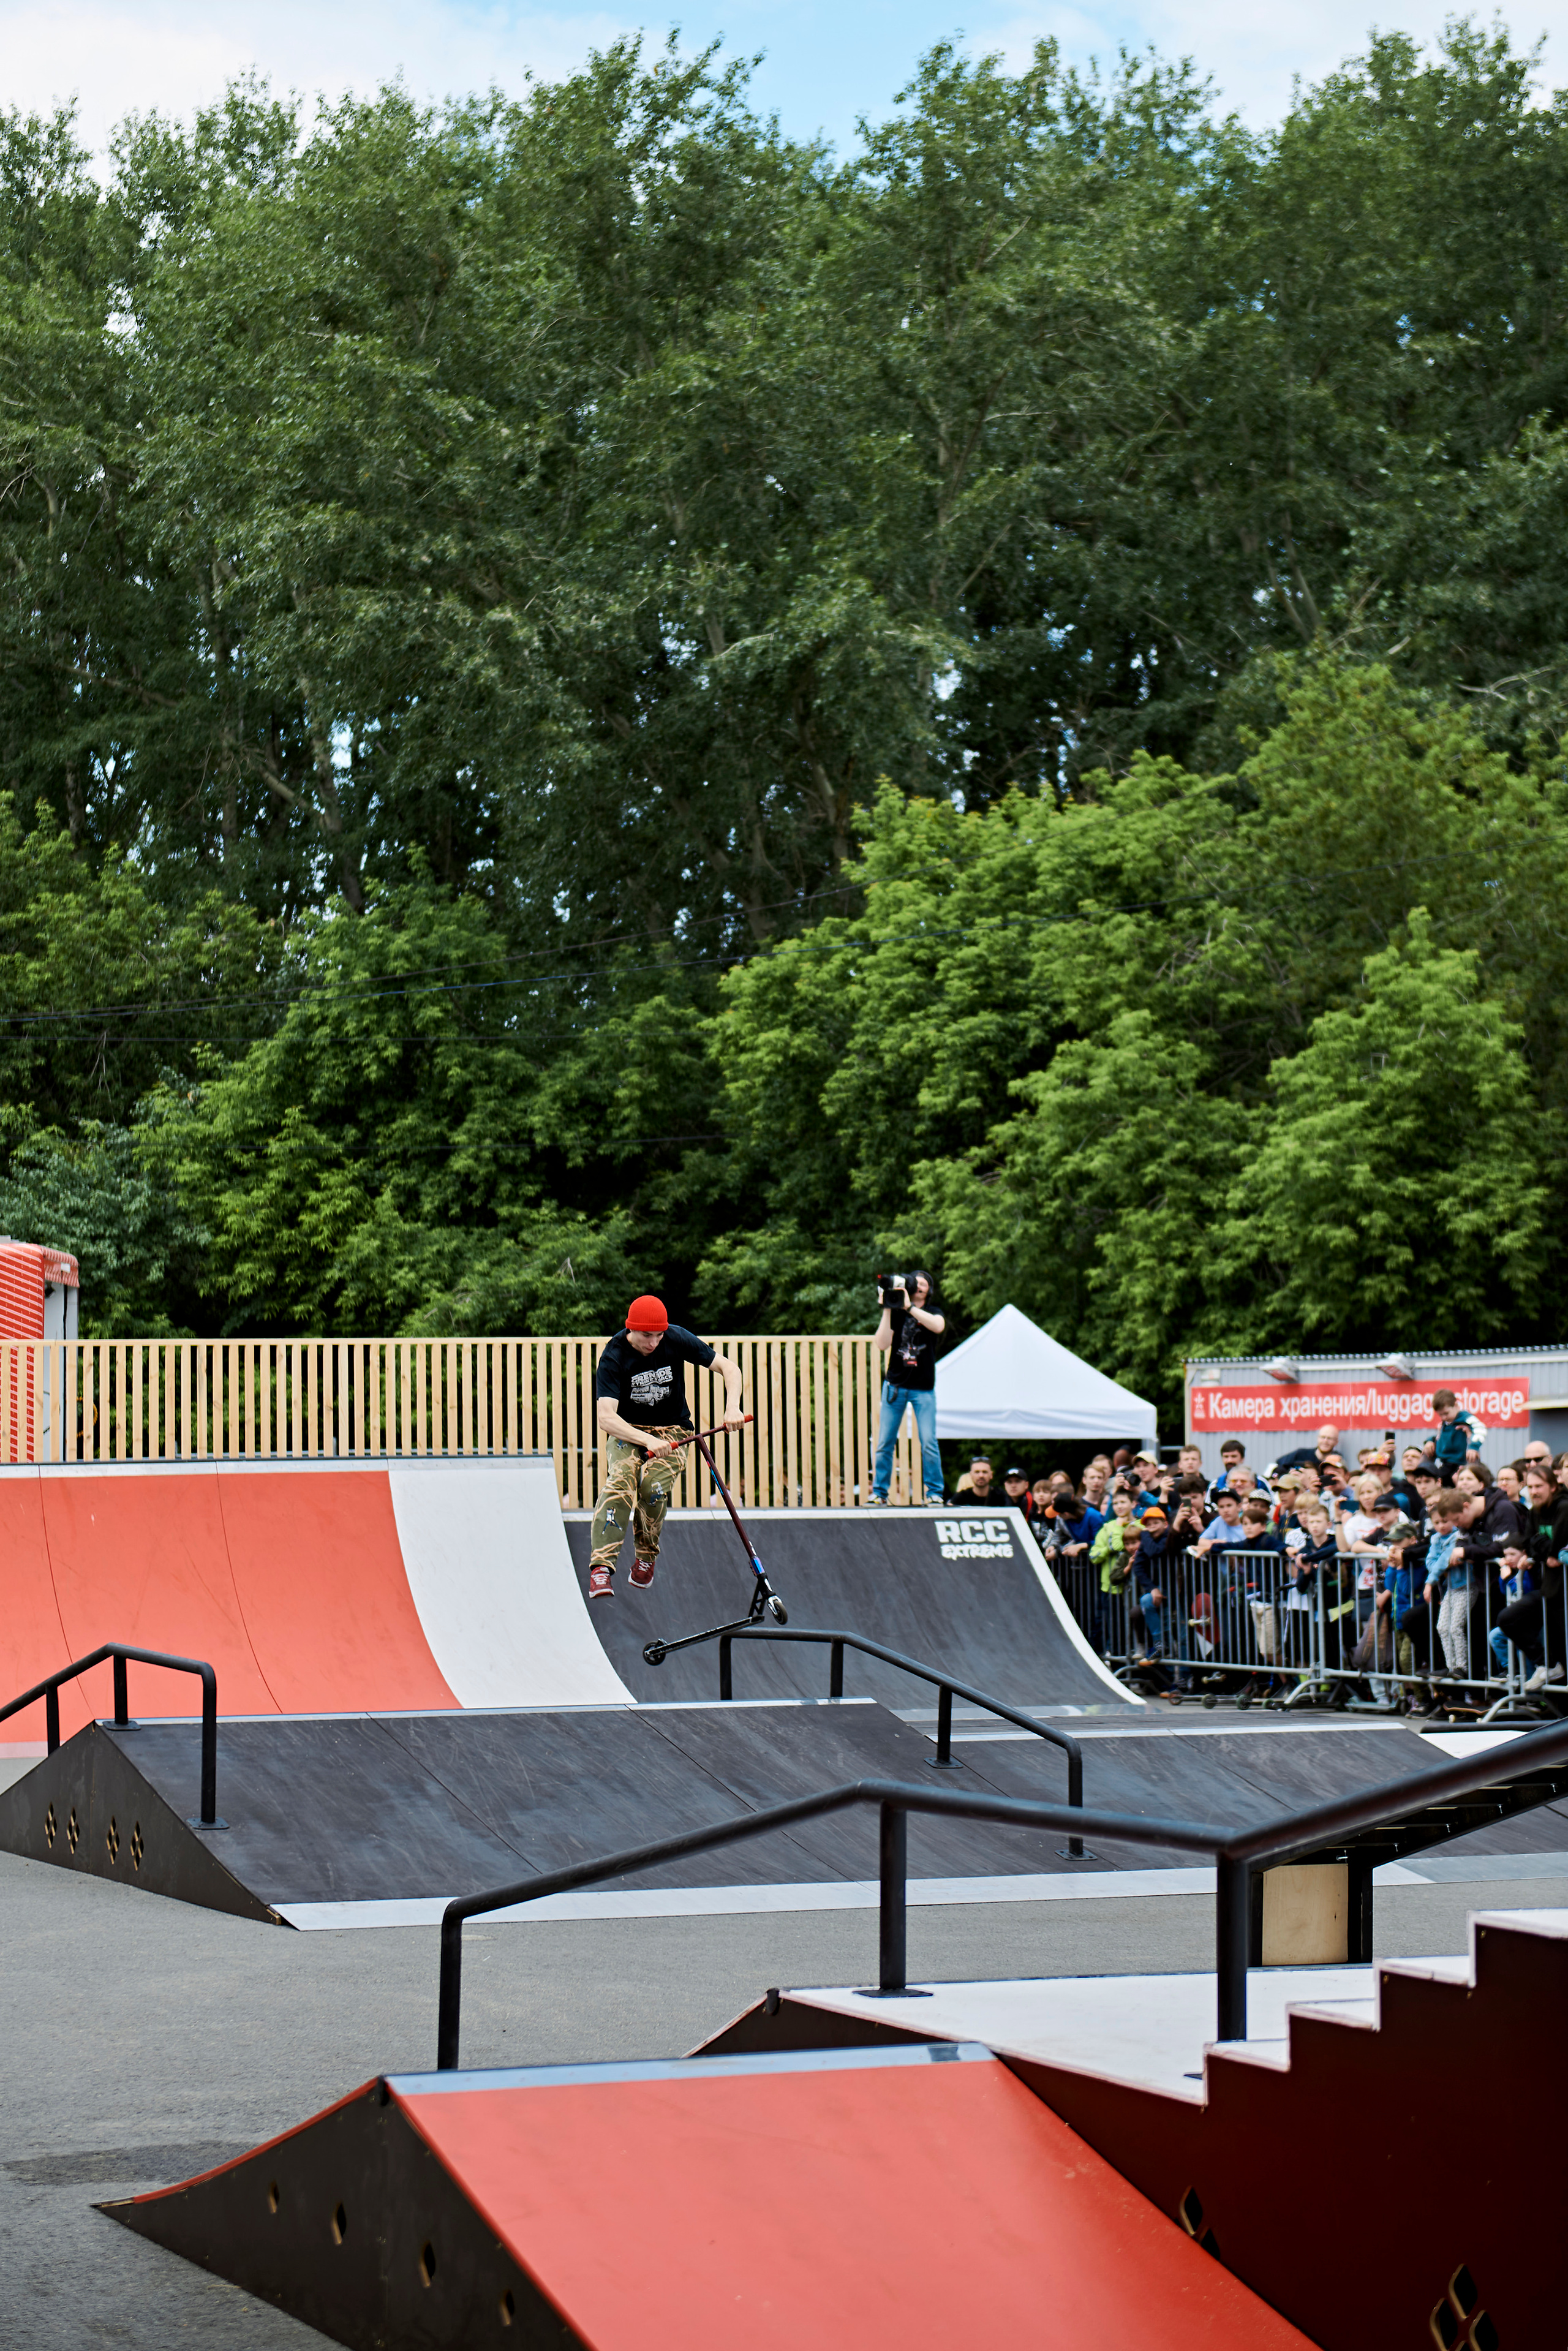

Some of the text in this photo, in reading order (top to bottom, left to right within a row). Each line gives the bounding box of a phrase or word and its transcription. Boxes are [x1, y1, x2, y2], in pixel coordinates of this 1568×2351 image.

[1209, 1386, 1525, 1424] Камера хранения/luggag storage
[934, 1520, 1010, 1542] RCC
[940, 1543, 1014, 1560] EXTREME
